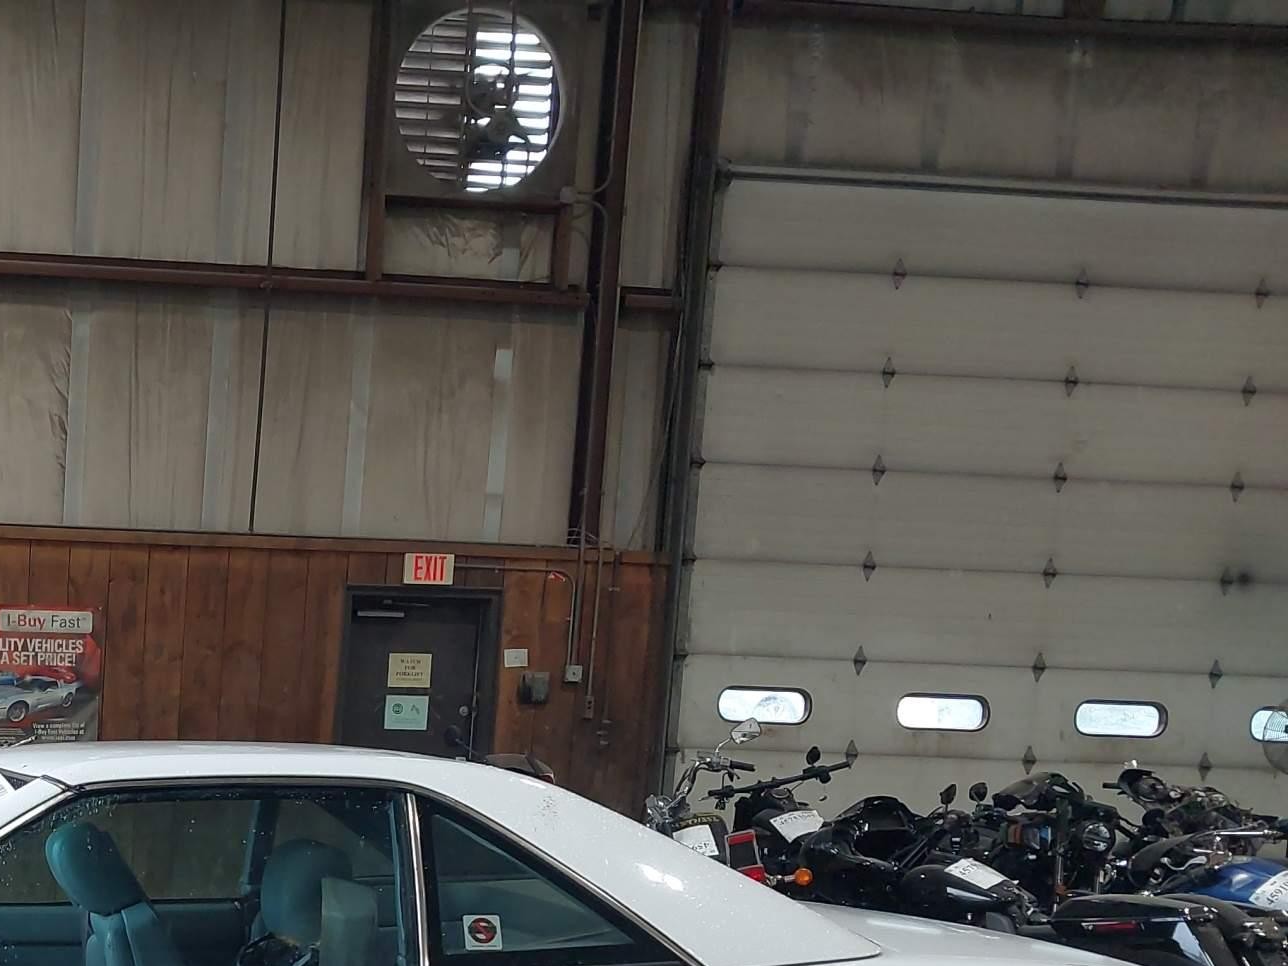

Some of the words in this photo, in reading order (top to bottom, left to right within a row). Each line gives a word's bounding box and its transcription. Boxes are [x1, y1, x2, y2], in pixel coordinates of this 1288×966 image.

[413, 555, 447, 582] EXIT
[7, 614, 46, 630] I-Buy
[26, 638, 84, 654] VEHICLES
[0, 652, 10, 665] A
[12, 652, 36, 666] SET
[37, 653, 77, 667] PRICE!
